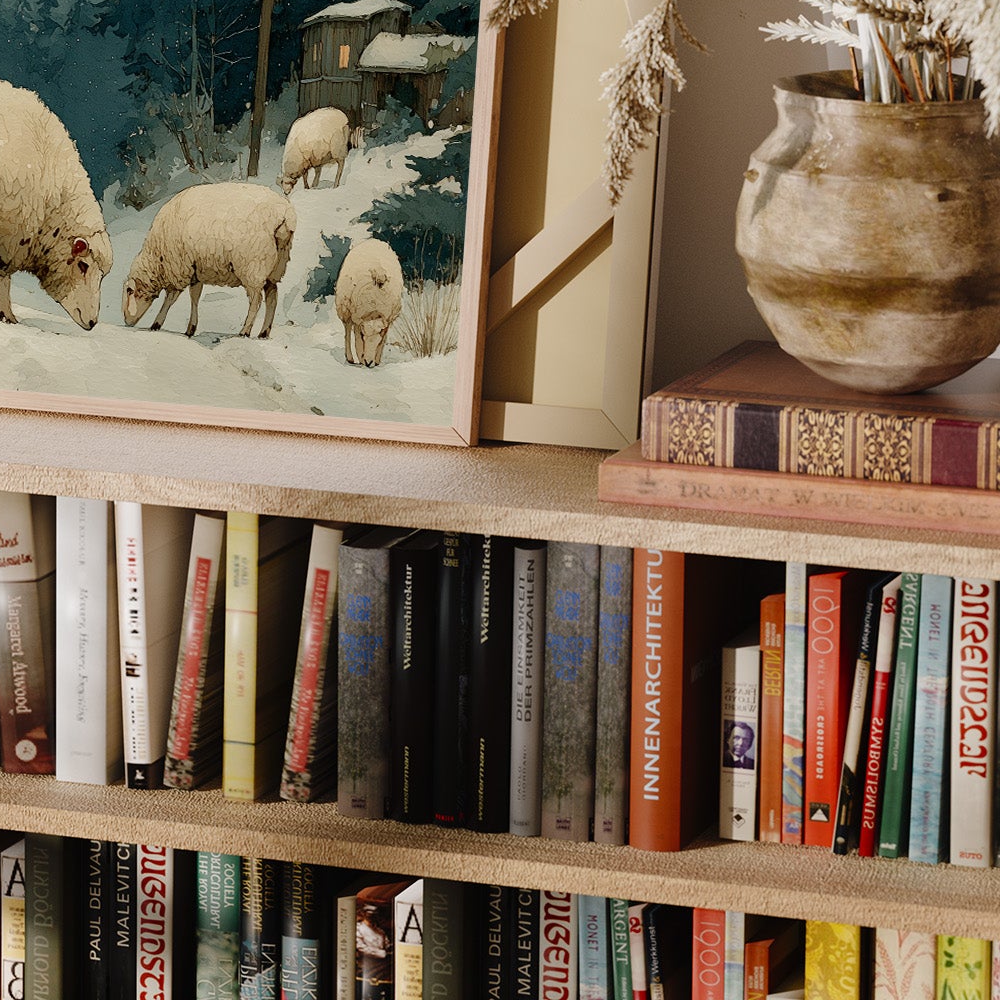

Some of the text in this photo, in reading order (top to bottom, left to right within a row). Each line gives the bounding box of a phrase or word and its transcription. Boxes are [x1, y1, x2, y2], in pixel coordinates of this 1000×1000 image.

[6, 595, 32, 713] Margaret Atwood
[403, 563, 413, 671] Weltarchitektur
[516, 573, 525, 685] EINSAMKEIT
[524, 559, 535, 722] DER PRIMZAHLEN
[477, 738, 486, 821] westermann
[89, 839, 101, 961] PAUL DELVAU
[587, 914, 599, 952] MONET
[630, 917, 641, 933] 2
[648, 926, 659, 974] Werkkunst
[693, 921, 721, 986] 1900
